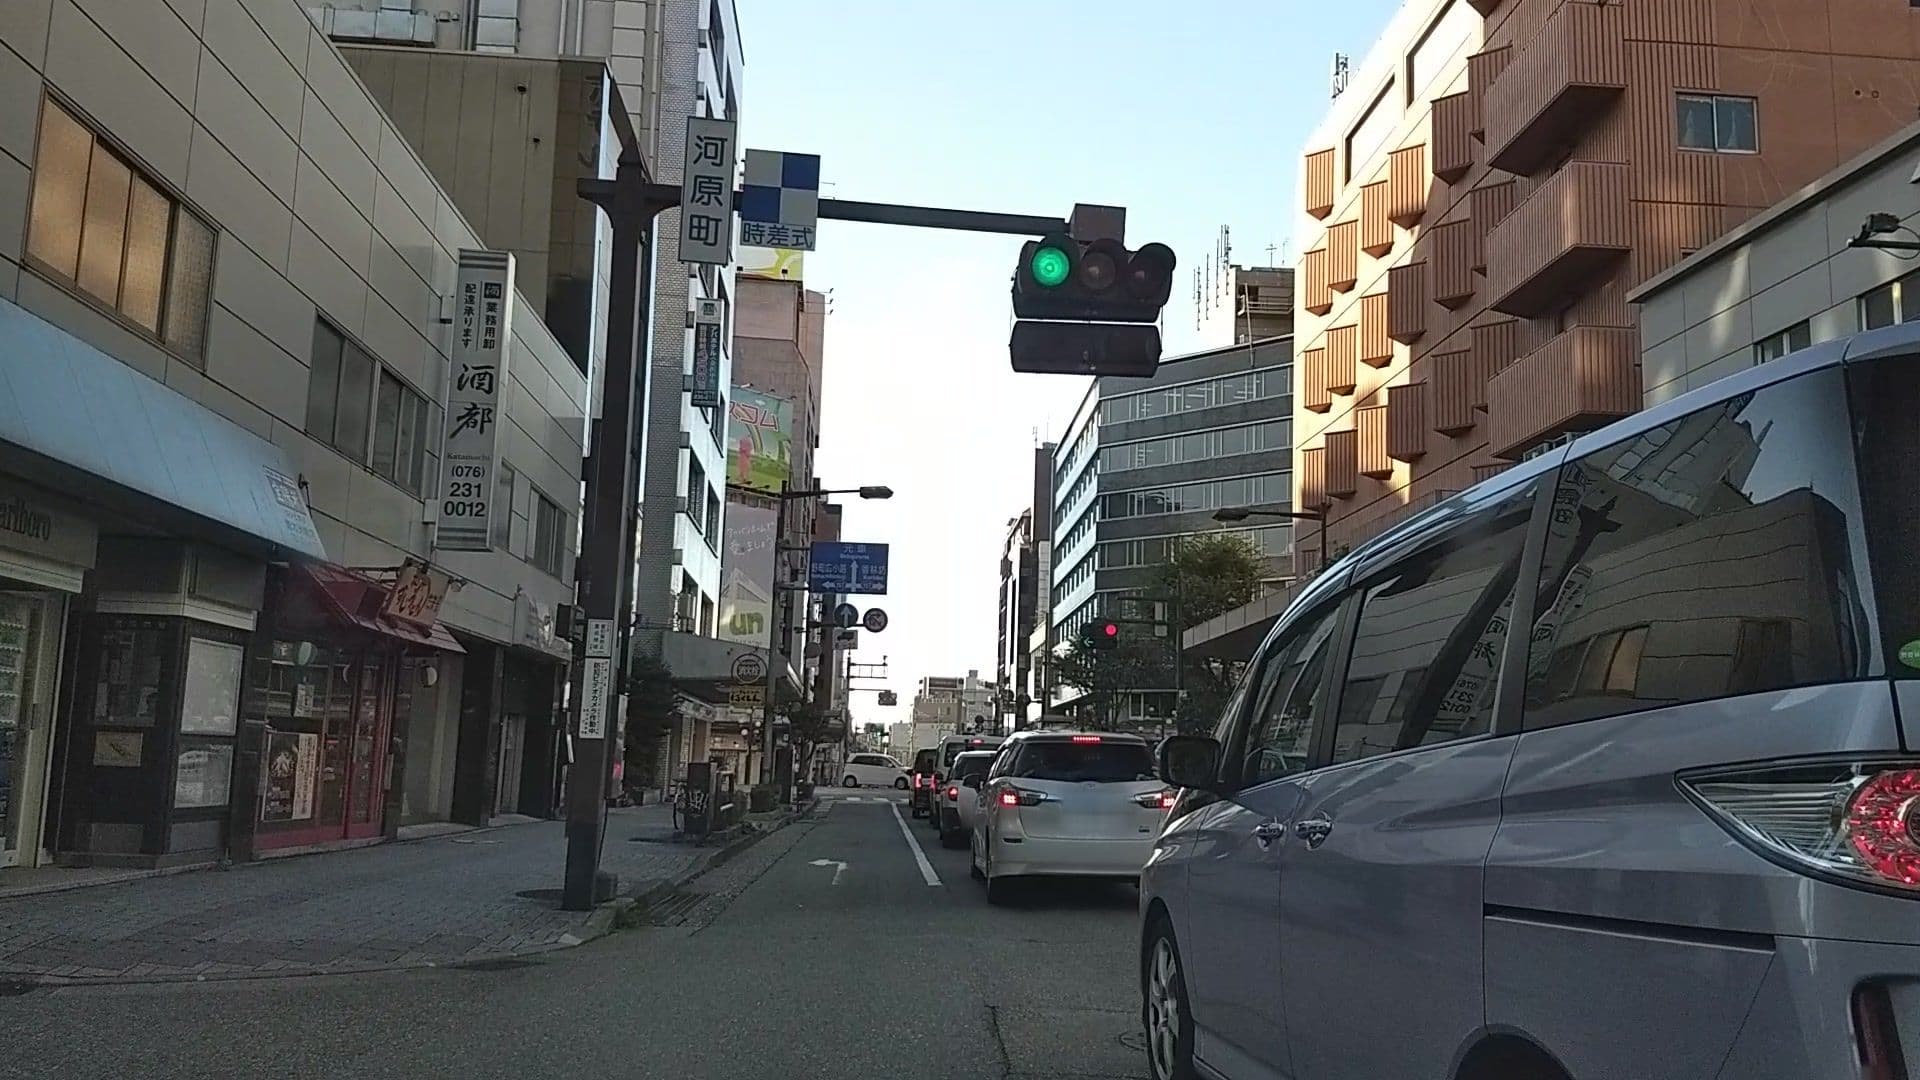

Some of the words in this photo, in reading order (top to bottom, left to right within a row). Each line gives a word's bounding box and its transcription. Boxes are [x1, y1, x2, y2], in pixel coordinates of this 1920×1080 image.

[688, 135, 728, 247] 河原町
[742, 222, 813, 249] 時差式
[460, 283, 477, 349] 配達承ります
[450, 362, 495, 440] 酒都
[451, 465, 486, 479] (076)
[450, 482, 483, 498] 231
[444, 501, 486, 518] 0012
